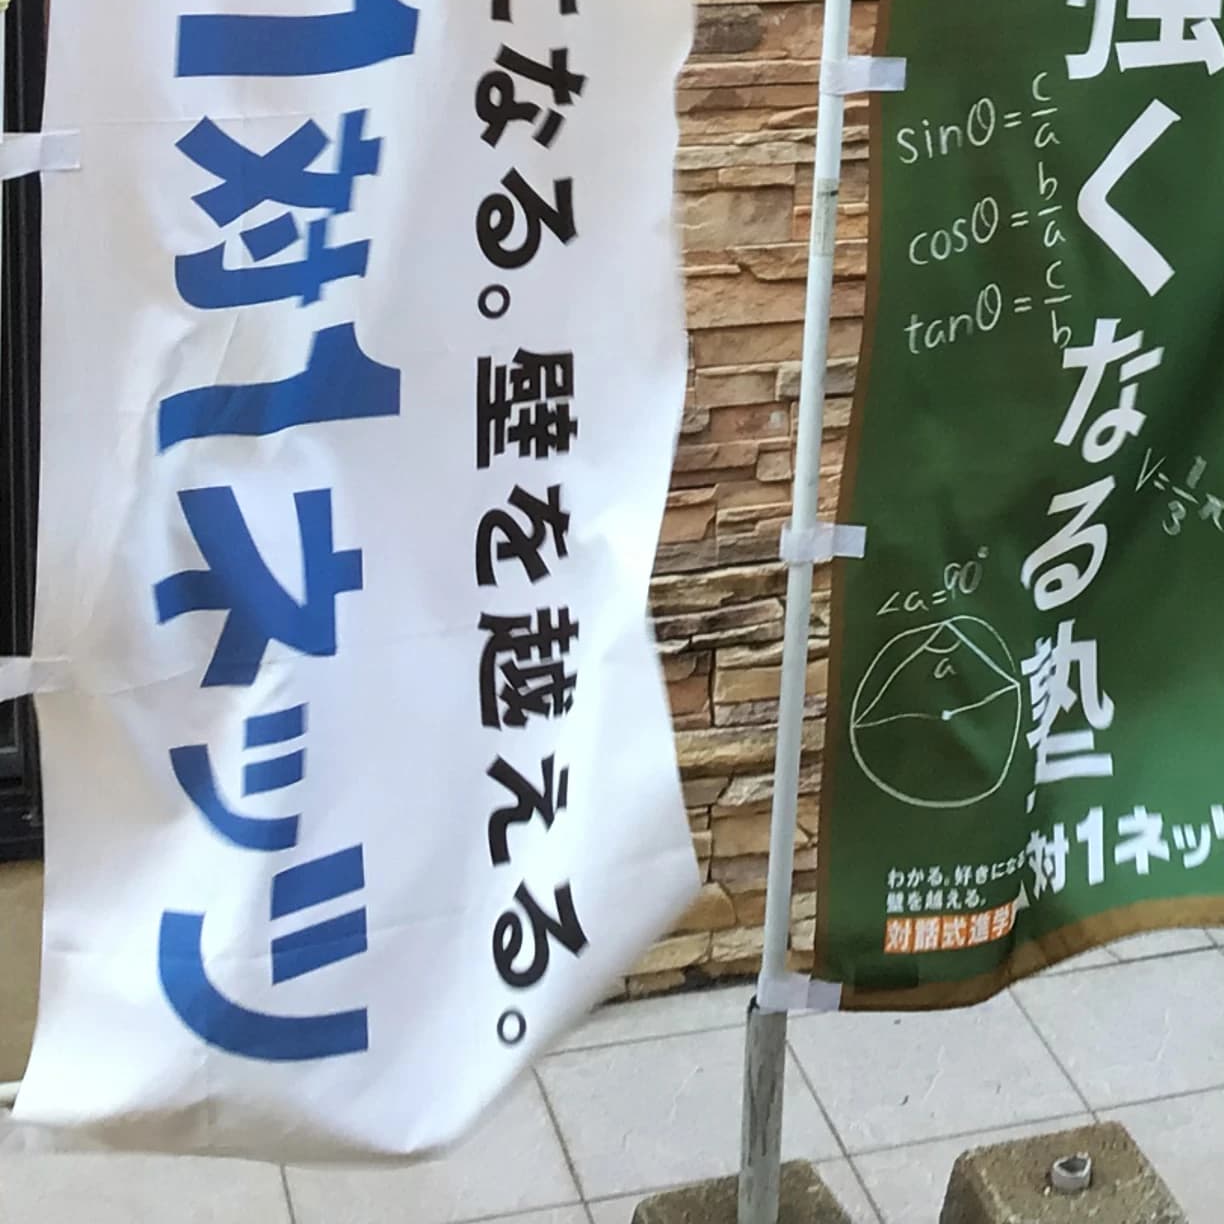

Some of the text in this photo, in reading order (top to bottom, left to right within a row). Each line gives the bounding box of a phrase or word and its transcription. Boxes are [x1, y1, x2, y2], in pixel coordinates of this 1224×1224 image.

[884, 902, 1022, 955] 対話式進学
